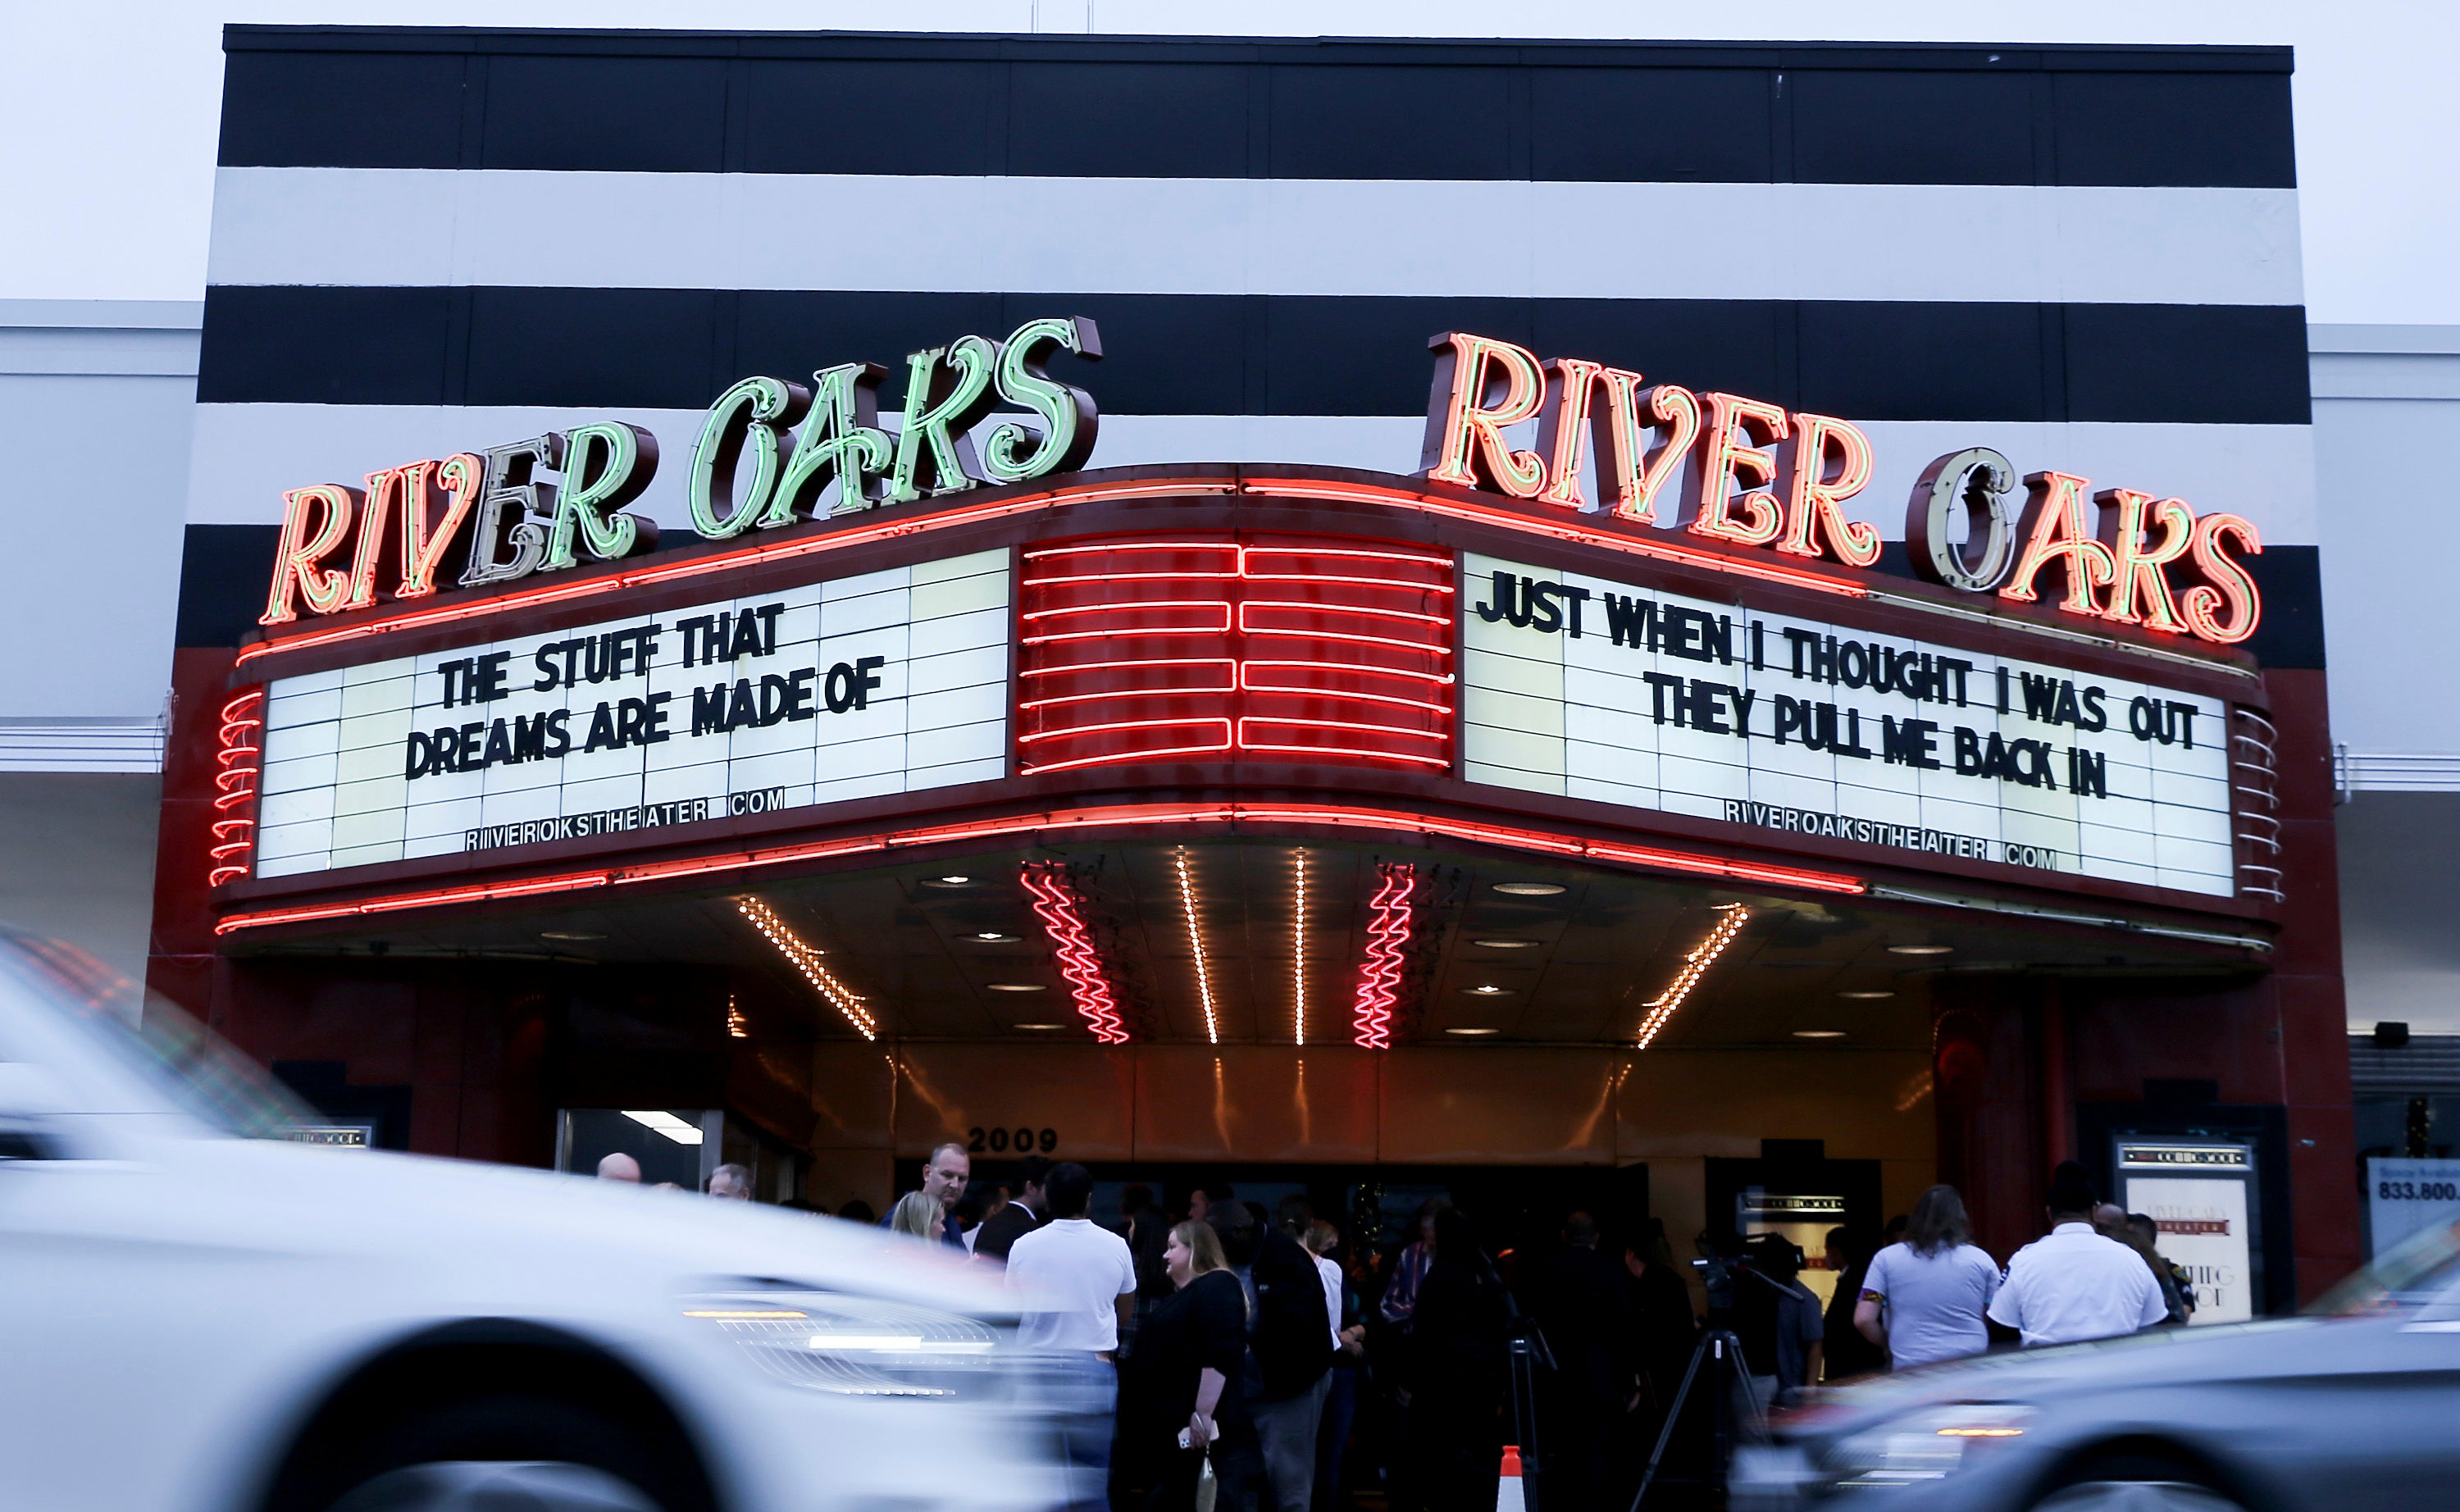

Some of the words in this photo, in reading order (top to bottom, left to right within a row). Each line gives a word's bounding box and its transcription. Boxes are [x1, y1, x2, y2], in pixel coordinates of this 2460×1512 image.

[259, 420, 656, 626] RIVER
[686, 315, 1104, 540] OAKS
[1424, 331, 1882, 567] RIVER
[1906, 447, 2262, 644] OAKS
[438, 650, 510, 708] THE
[534, 624, 661, 693] STUFF
[676, 602, 785, 668] THAT
[1476, 571, 1590, 639] JUST
[1604, 592, 1732, 666] WHEN
[1752, 621, 1764, 671] I
[1784, 626, 1972, 708] THOUGHT
[1998, 667, 2009, 715] I
[2020, 672, 2107, 732] WAS
[2130, 695, 2198, 749] OUT
[405, 708, 571, 781] DREAMS
[584, 691, 672, 754] ARE
[691, 667, 816, 737] MADE
[824, 656, 884, 714] OF
[1642, 671, 1756, 738] THEY
[1775, 694, 1870, 759] PULL
[1882, 715, 1940, 770] ME
[1954, 726, 2057, 790] BACK
[2068, 746, 2107, 799] IN
[731, 788, 784, 816] COM
[1724, 800, 1987, 859] RIVEROAKSTHEATER
[2006, 842, 2056, 870] COM
[968, 1127, 1058, 1153] 2009
